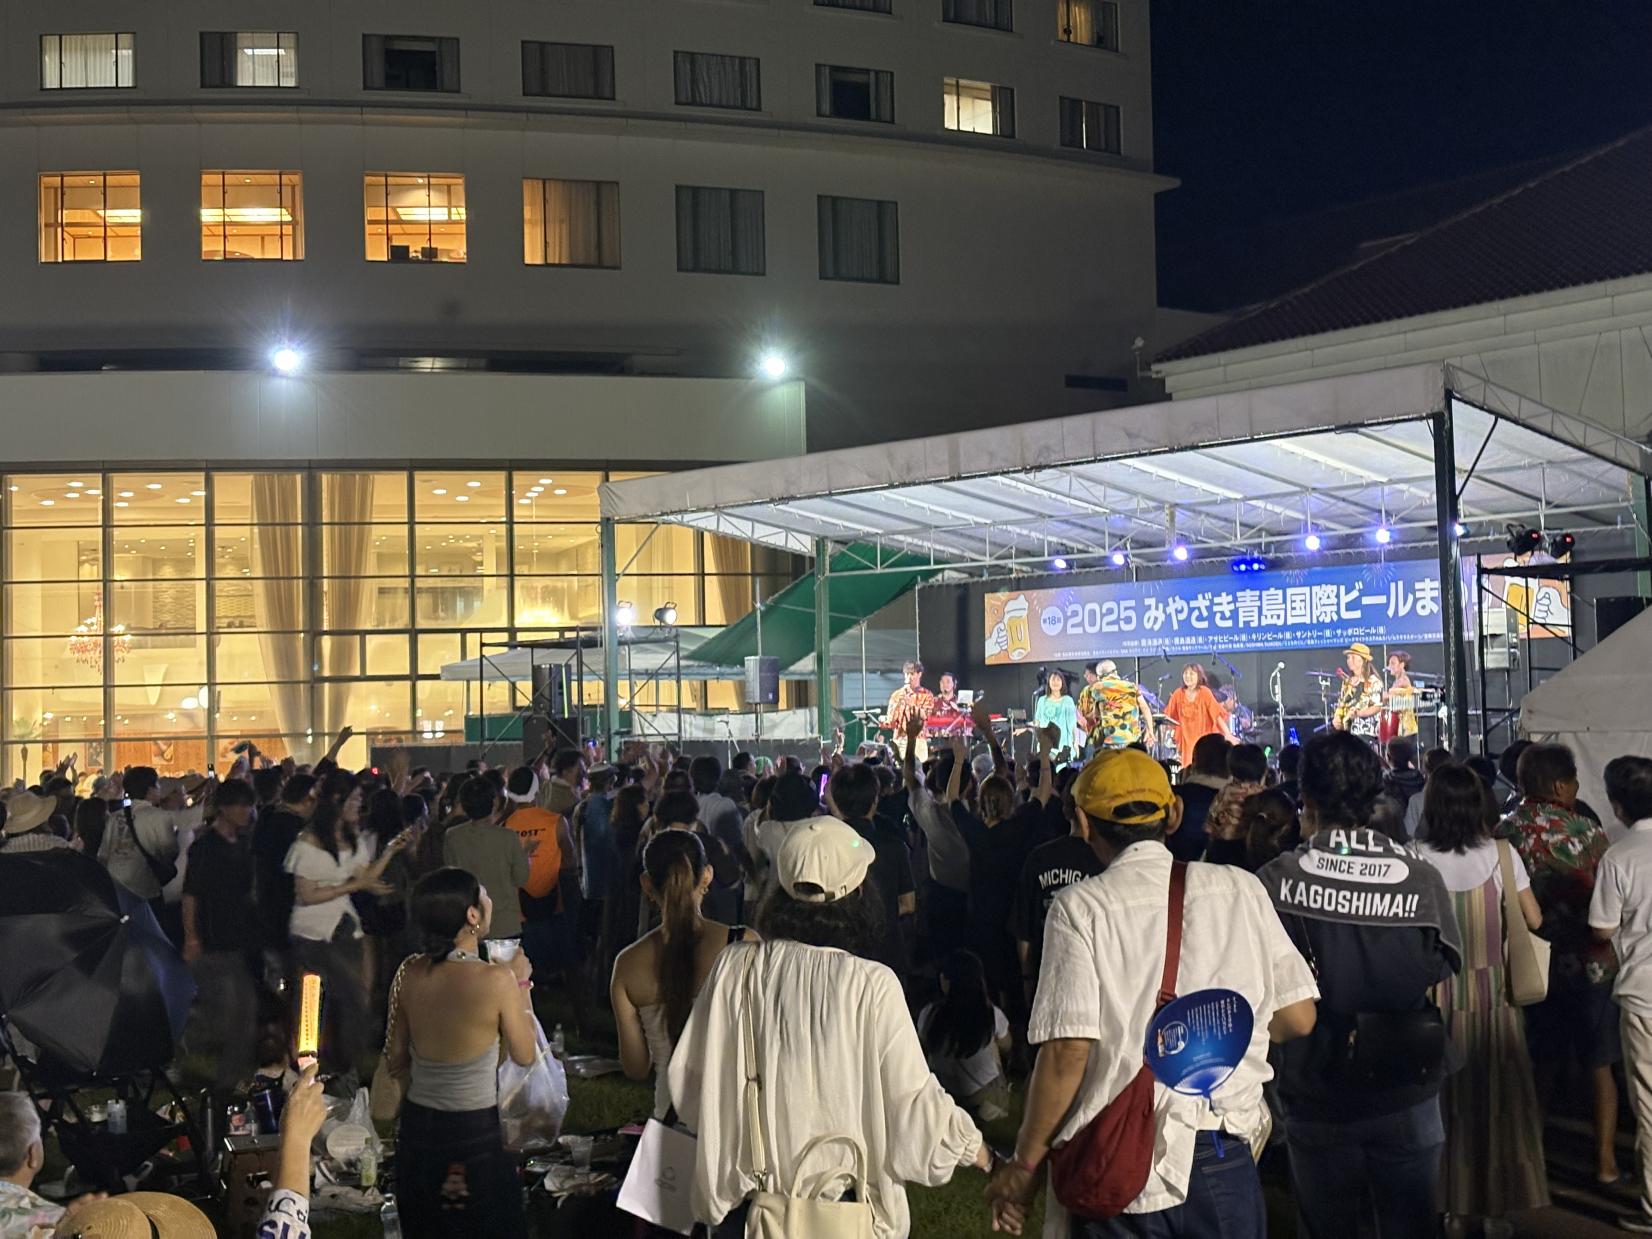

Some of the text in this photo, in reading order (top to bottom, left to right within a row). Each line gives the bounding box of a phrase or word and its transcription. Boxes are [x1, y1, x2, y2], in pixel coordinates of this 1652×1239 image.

[1066, 575, 1492, 634] 2025 みやざき青島国際ビールまり
[1316, 857, 1391, 877] SINCE 2017
[1280, 877, 1419, 917] KAGOSHIMA!!
